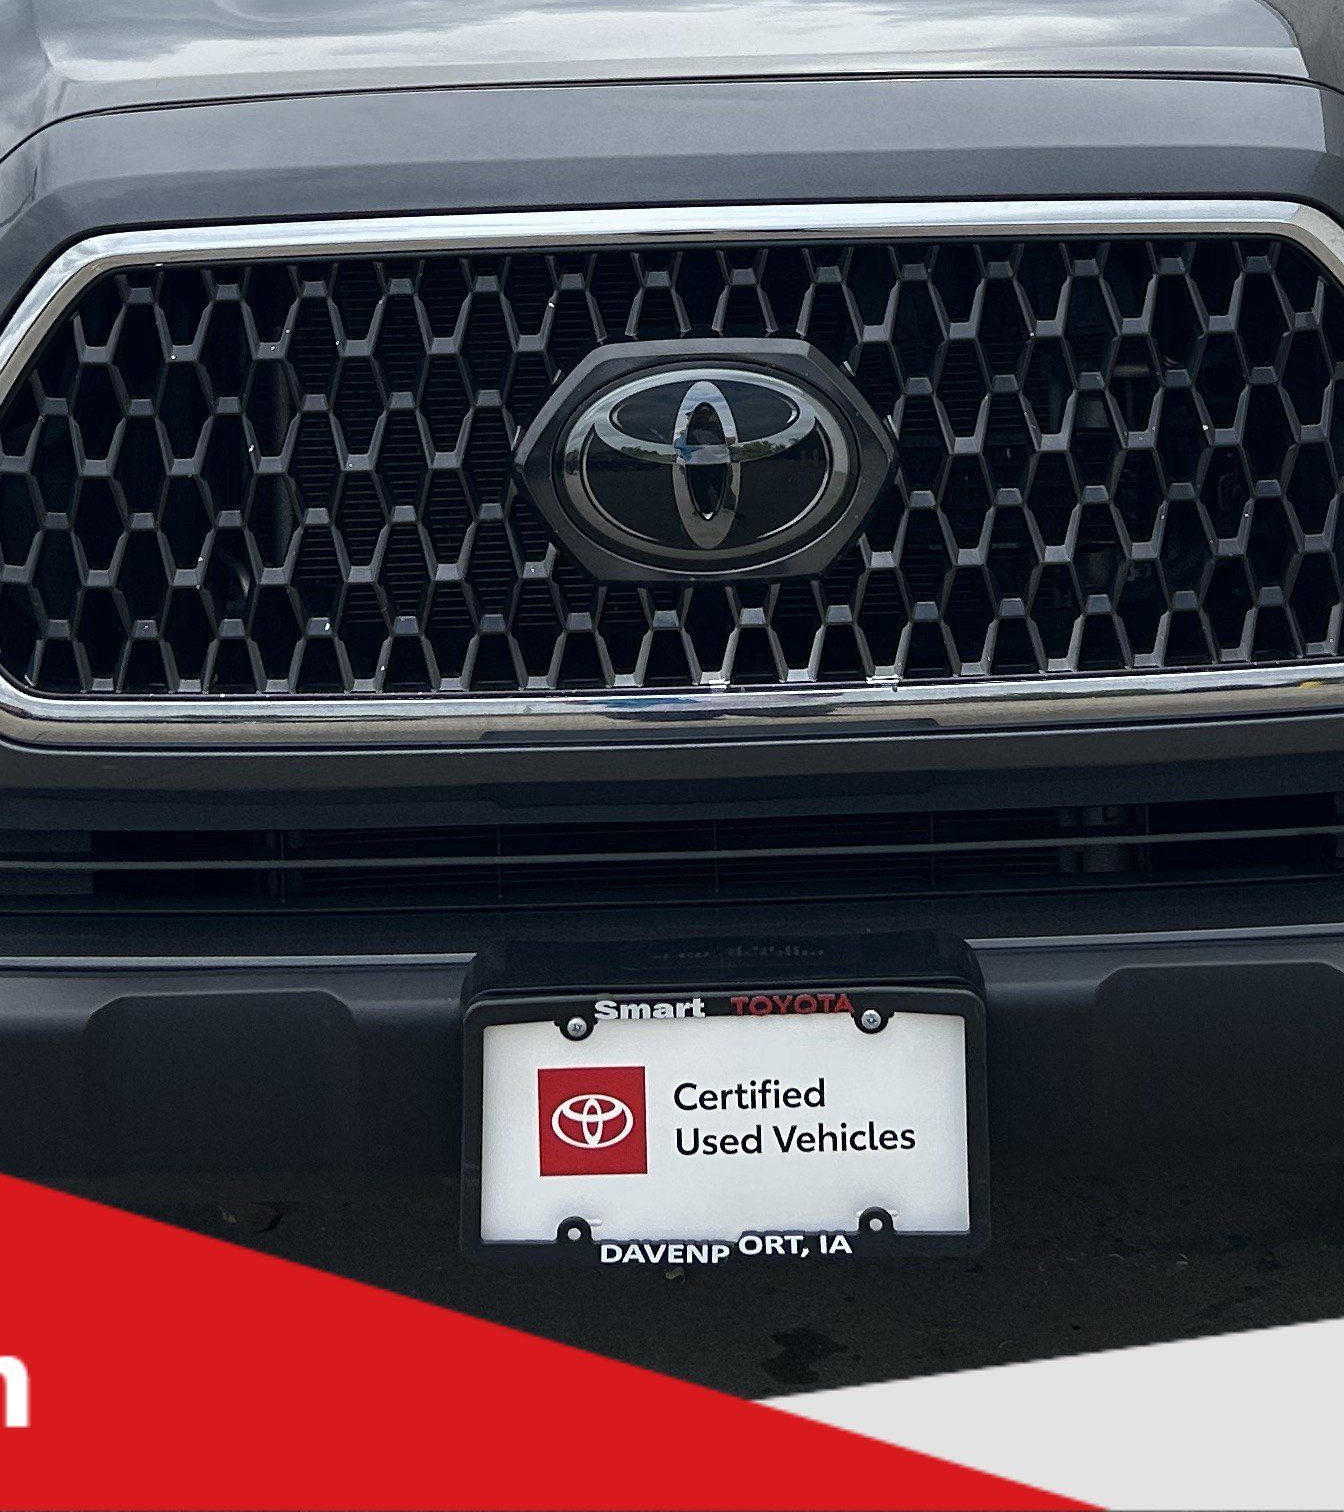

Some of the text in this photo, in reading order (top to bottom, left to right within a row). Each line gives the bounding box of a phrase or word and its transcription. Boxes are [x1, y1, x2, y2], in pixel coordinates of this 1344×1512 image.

[594, 993, 855, 1021] Smart TOYOTA
[673, 1077, 826, 1111] Certified
[676, 1120, 916, 1156] Used Vehicles
[819, 1234, 853, 1254] IA
